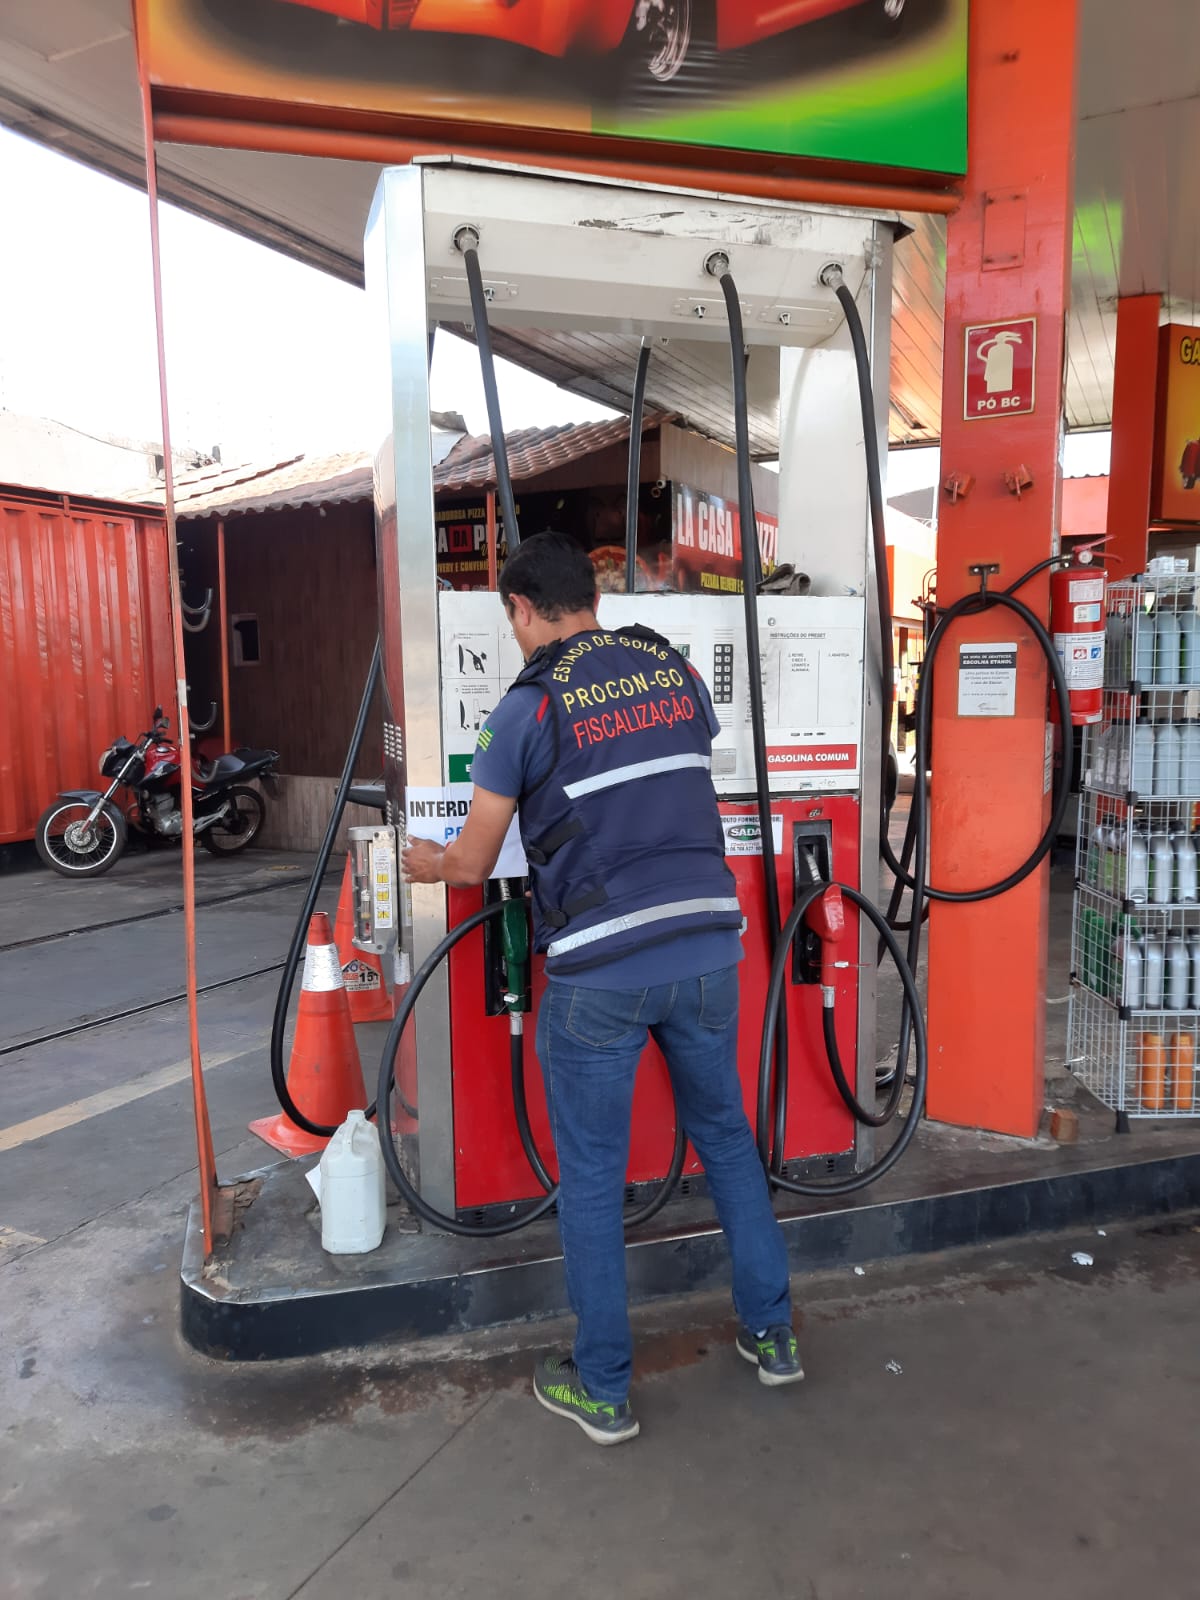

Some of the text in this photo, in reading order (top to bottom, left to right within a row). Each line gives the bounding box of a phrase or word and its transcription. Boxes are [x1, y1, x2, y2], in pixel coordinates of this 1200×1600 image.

[977, 395, 1021, 411] PÓ BC
[677, 493, 694, 548] LA
[698, 501, 734, 558] CASA
[553, 634, 669, 683] ESTADO DE GOIÁS
[562, 668, 684, 714] PROCON-GO
[572, 690, 695, 749] FISCALIZAÇÃO
[768, 753, 849, 763] GASOLINA COMUM
